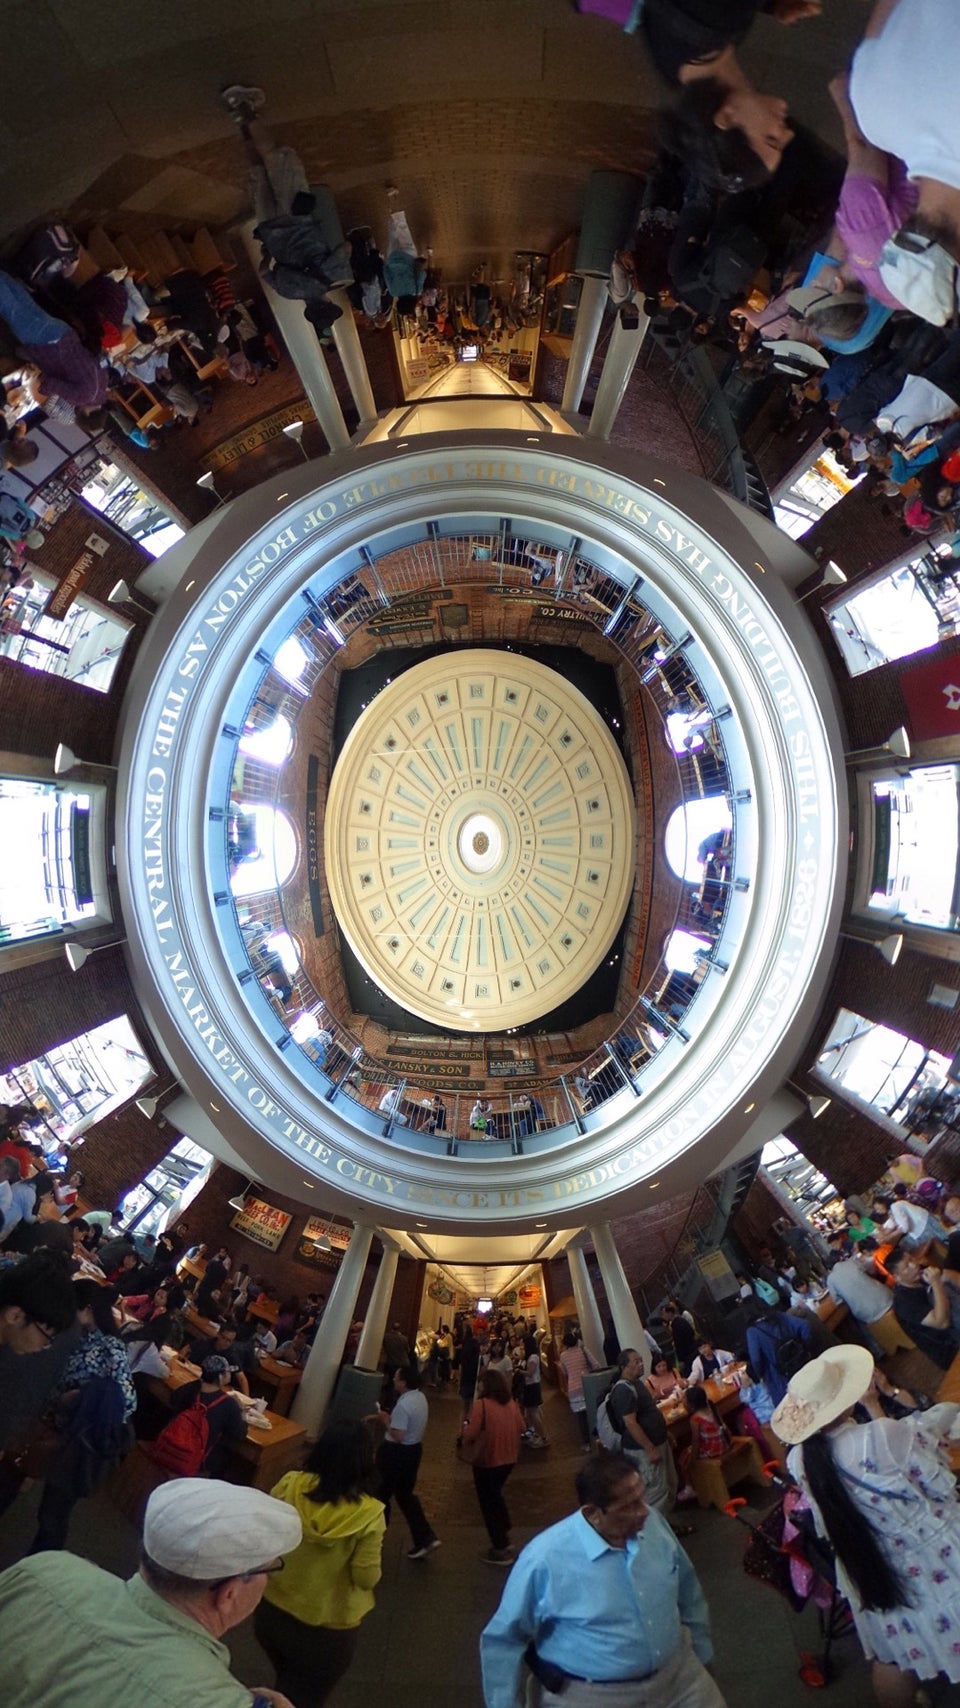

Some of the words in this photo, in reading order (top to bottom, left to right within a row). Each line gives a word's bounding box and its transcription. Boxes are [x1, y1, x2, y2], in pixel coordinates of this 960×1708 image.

[465, 459, 527, 479] THE
[535, 466, 652, 526] SERVED
[297, 498, 338, 533] OF
[653, 518, 711, 573] HAS
[203, 525, 298, 631] BOSTON
[540, 607, 555, 616] CO.
[176, 630, 212, 680] AS
[709, 571, 802, 723] BUILDING
[151, 683, 187, 758] THE
[789, 729, 819, 822] THIS
[143, 765, 175, 944] CENTRAL
[309, 811, 317, 880] EGGS
[786, 858, 817, 941] 1826
[164, 949, 248, 1088] MARKET
[387, 1061, 427, 1073] LANSKY
[438, 1065, 463, 1074] SON
[243, 1083, 280, 1123] OF
[278, 1117, 332, 1164] THE
[552, 1104, 700, 1199] DEDICATION
[334, 1155, 401, 1196] CITY
[498, 1185, 545, 1207] ITS
